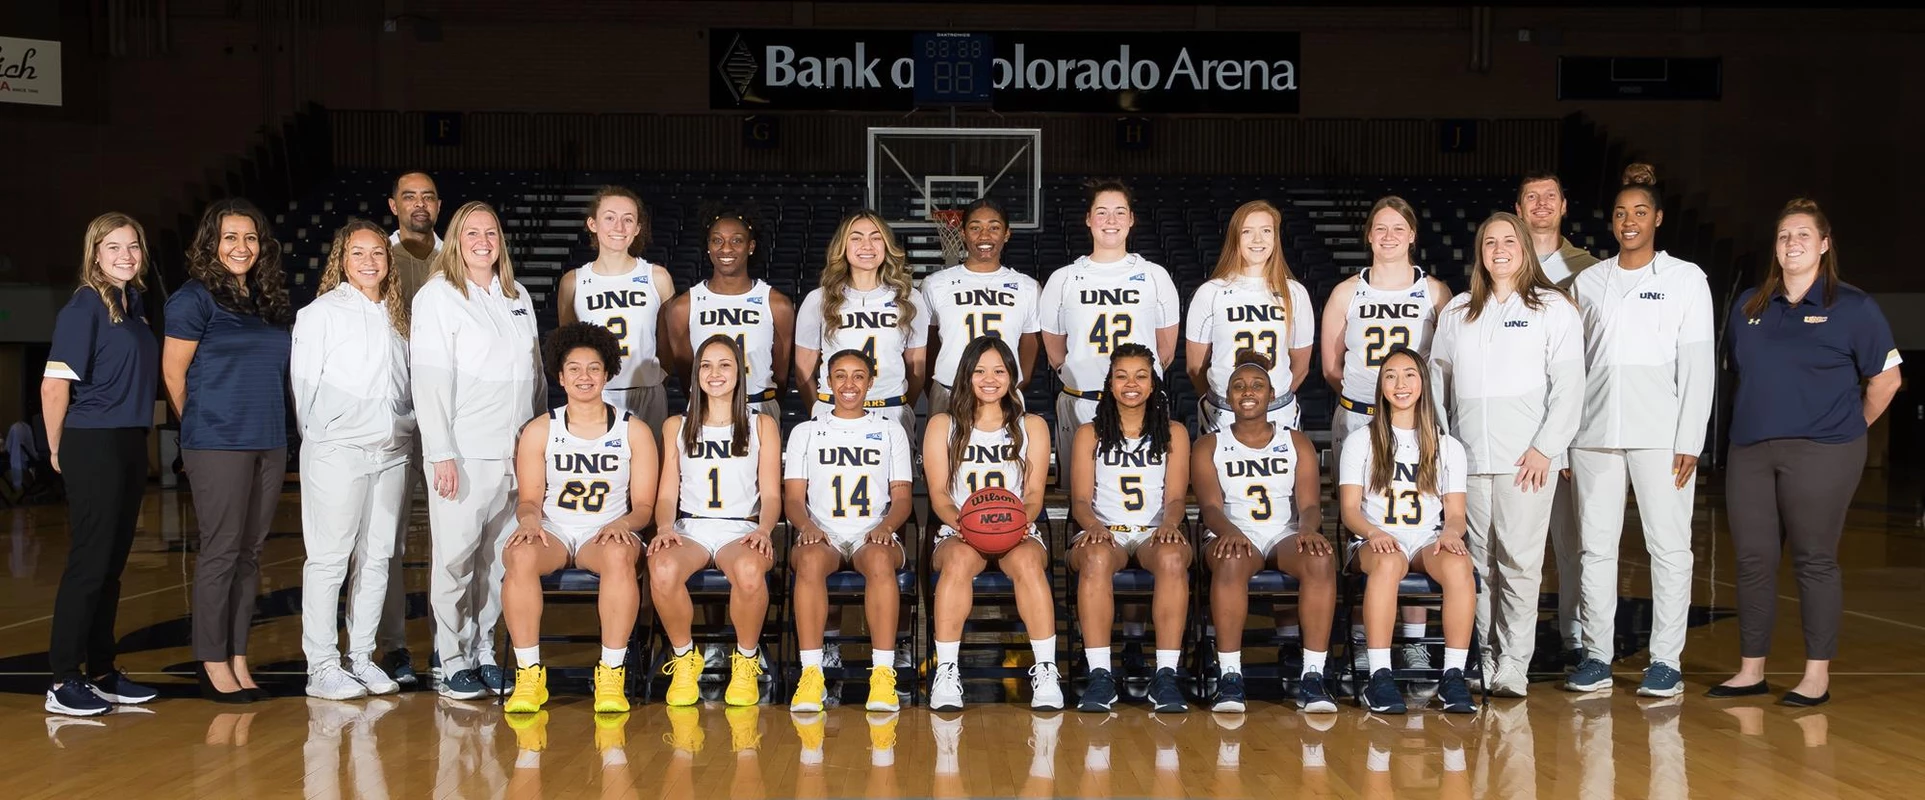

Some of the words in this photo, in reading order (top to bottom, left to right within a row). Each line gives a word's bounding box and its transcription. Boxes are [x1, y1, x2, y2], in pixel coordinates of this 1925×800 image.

[0, 45, 38, 80] ich
[765, 42, 881, 89] Bank
[891, 57, 914, 89] o
[992, 43, 1160, 90] olorado
[1164, 47, 1297, 90] Arena
[438, 119, 450, 138] F
[752, 122, 770, 141] G
[1126, 124, 1141, 143] H
[1452, 126, 1462, 149] J
[586, 290, 647, 311] UNC
[953, 288, 1016, 307] UNC
[1080, 288, 1141, 306] UNC
[1639, 291, 1665, 300] UNC
[700, 308, 760, 326] UNC
[838, 311, 898, 329] UNC
[1226, 304, 1285, 322] UNC
[1359, 303, 1420, 320] UNC
[963, 312, 1005, 341] 15
[1089, 313, 1132, 354] 42
[1504, 320, 1529, 328] UNC
[606, 315, 630, 357] 2
[861, 335, 878, 377] 4
[1234, 330, 1277, 371] 23
[1364, 325, 1411, 368] 22
[863, 399, 886, 408] ARS
[687, 440, 749, 459] UN
[818, 447, 881, 466] UNC
[554, 453, 619, 474] UNC
[1225, 457, 1289, 477] UNC
[708, 467, 722, 508] 1
[831, 475, 871, 517] 14
[1120, 476, 1144, 511] 5
[971, 493, 1017, 507] Wilson
[1247, 485, 1271, 521] 3
[1384, 489, 1422, 525] 13
[980, 512, 1013, 524] NCAA
